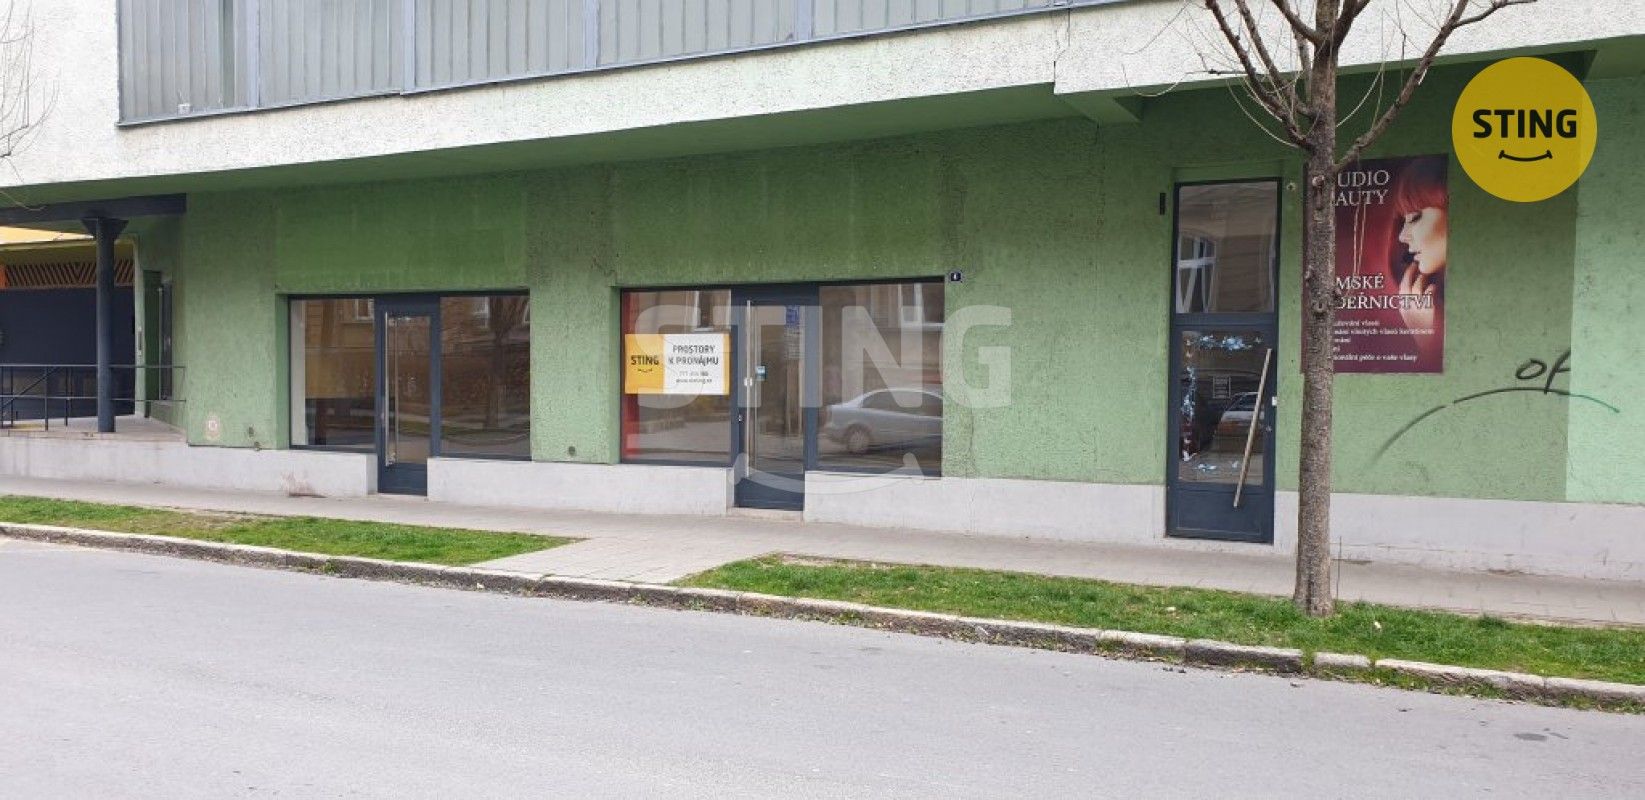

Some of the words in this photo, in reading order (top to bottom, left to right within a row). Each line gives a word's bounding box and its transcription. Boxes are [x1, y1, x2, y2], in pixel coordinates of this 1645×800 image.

[1337, 170, 1390, 187] UDIO
[1334, 189, 1388, 206] AUTY
[1336, 273, 1384, 290] MSKÉ
[1335, 292, 1433, 309] DEŘNICTVÍ
[673, 345, 715, 354] PROSTORY
[630, 354, 659, 366] STING
[676, 355, 719, 366] PRONÁJMU
